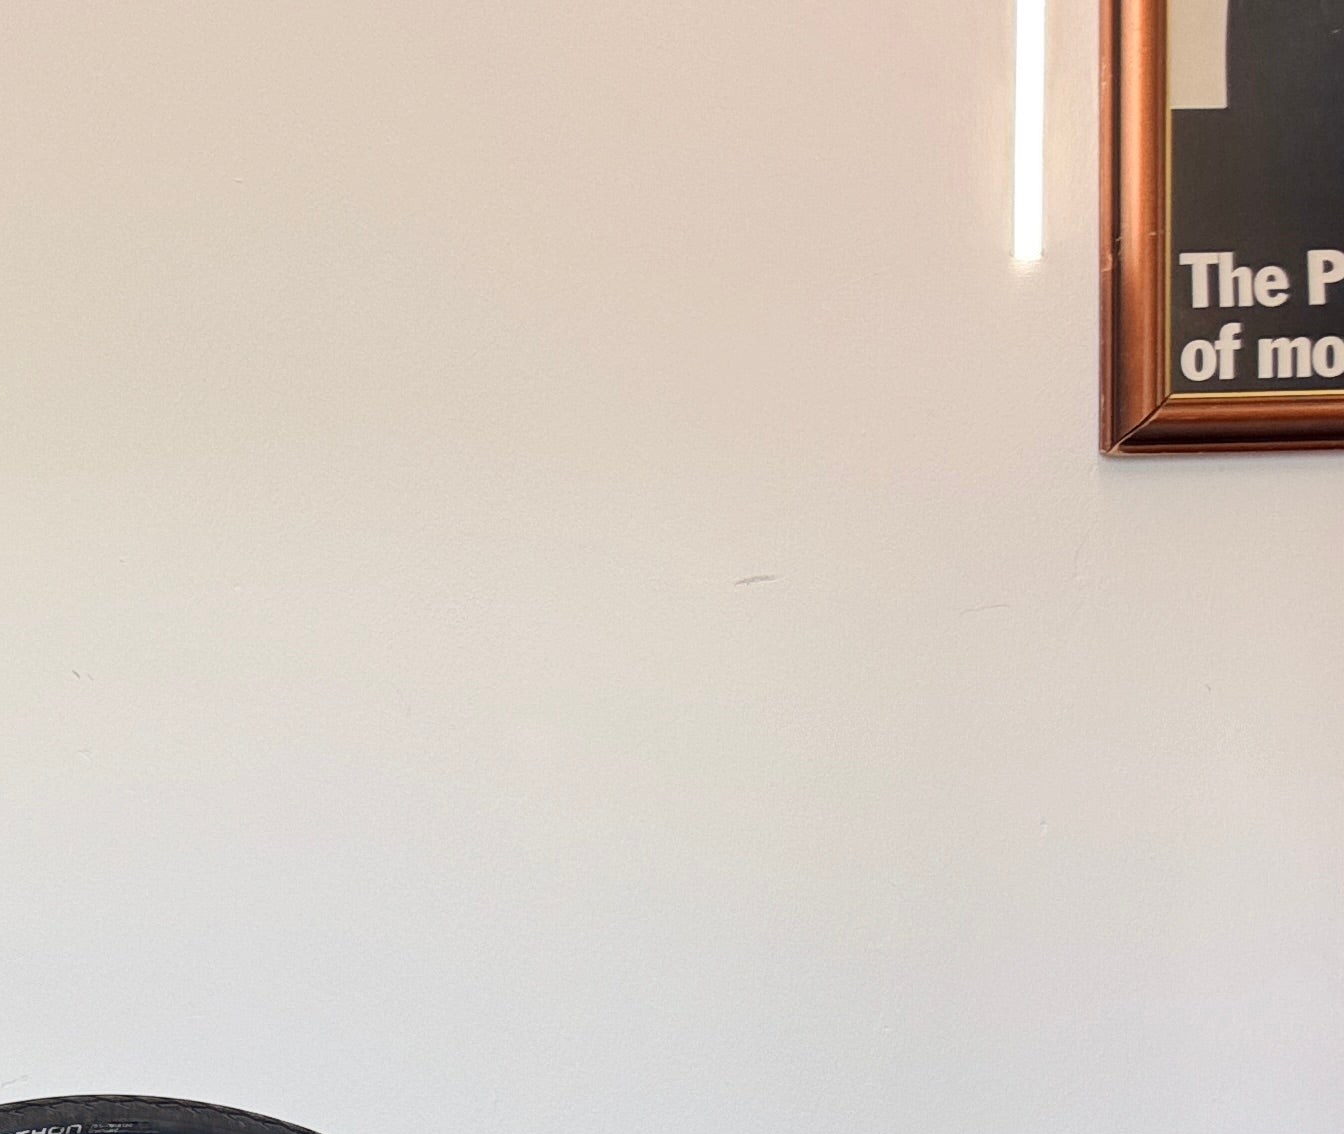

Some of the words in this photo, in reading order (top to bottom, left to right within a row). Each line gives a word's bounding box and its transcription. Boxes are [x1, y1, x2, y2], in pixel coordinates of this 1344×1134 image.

[1179, 251, 1290, 309] The
[1180, 322, 1243, 381] of
[1257, 336, 1344, 379] mo
